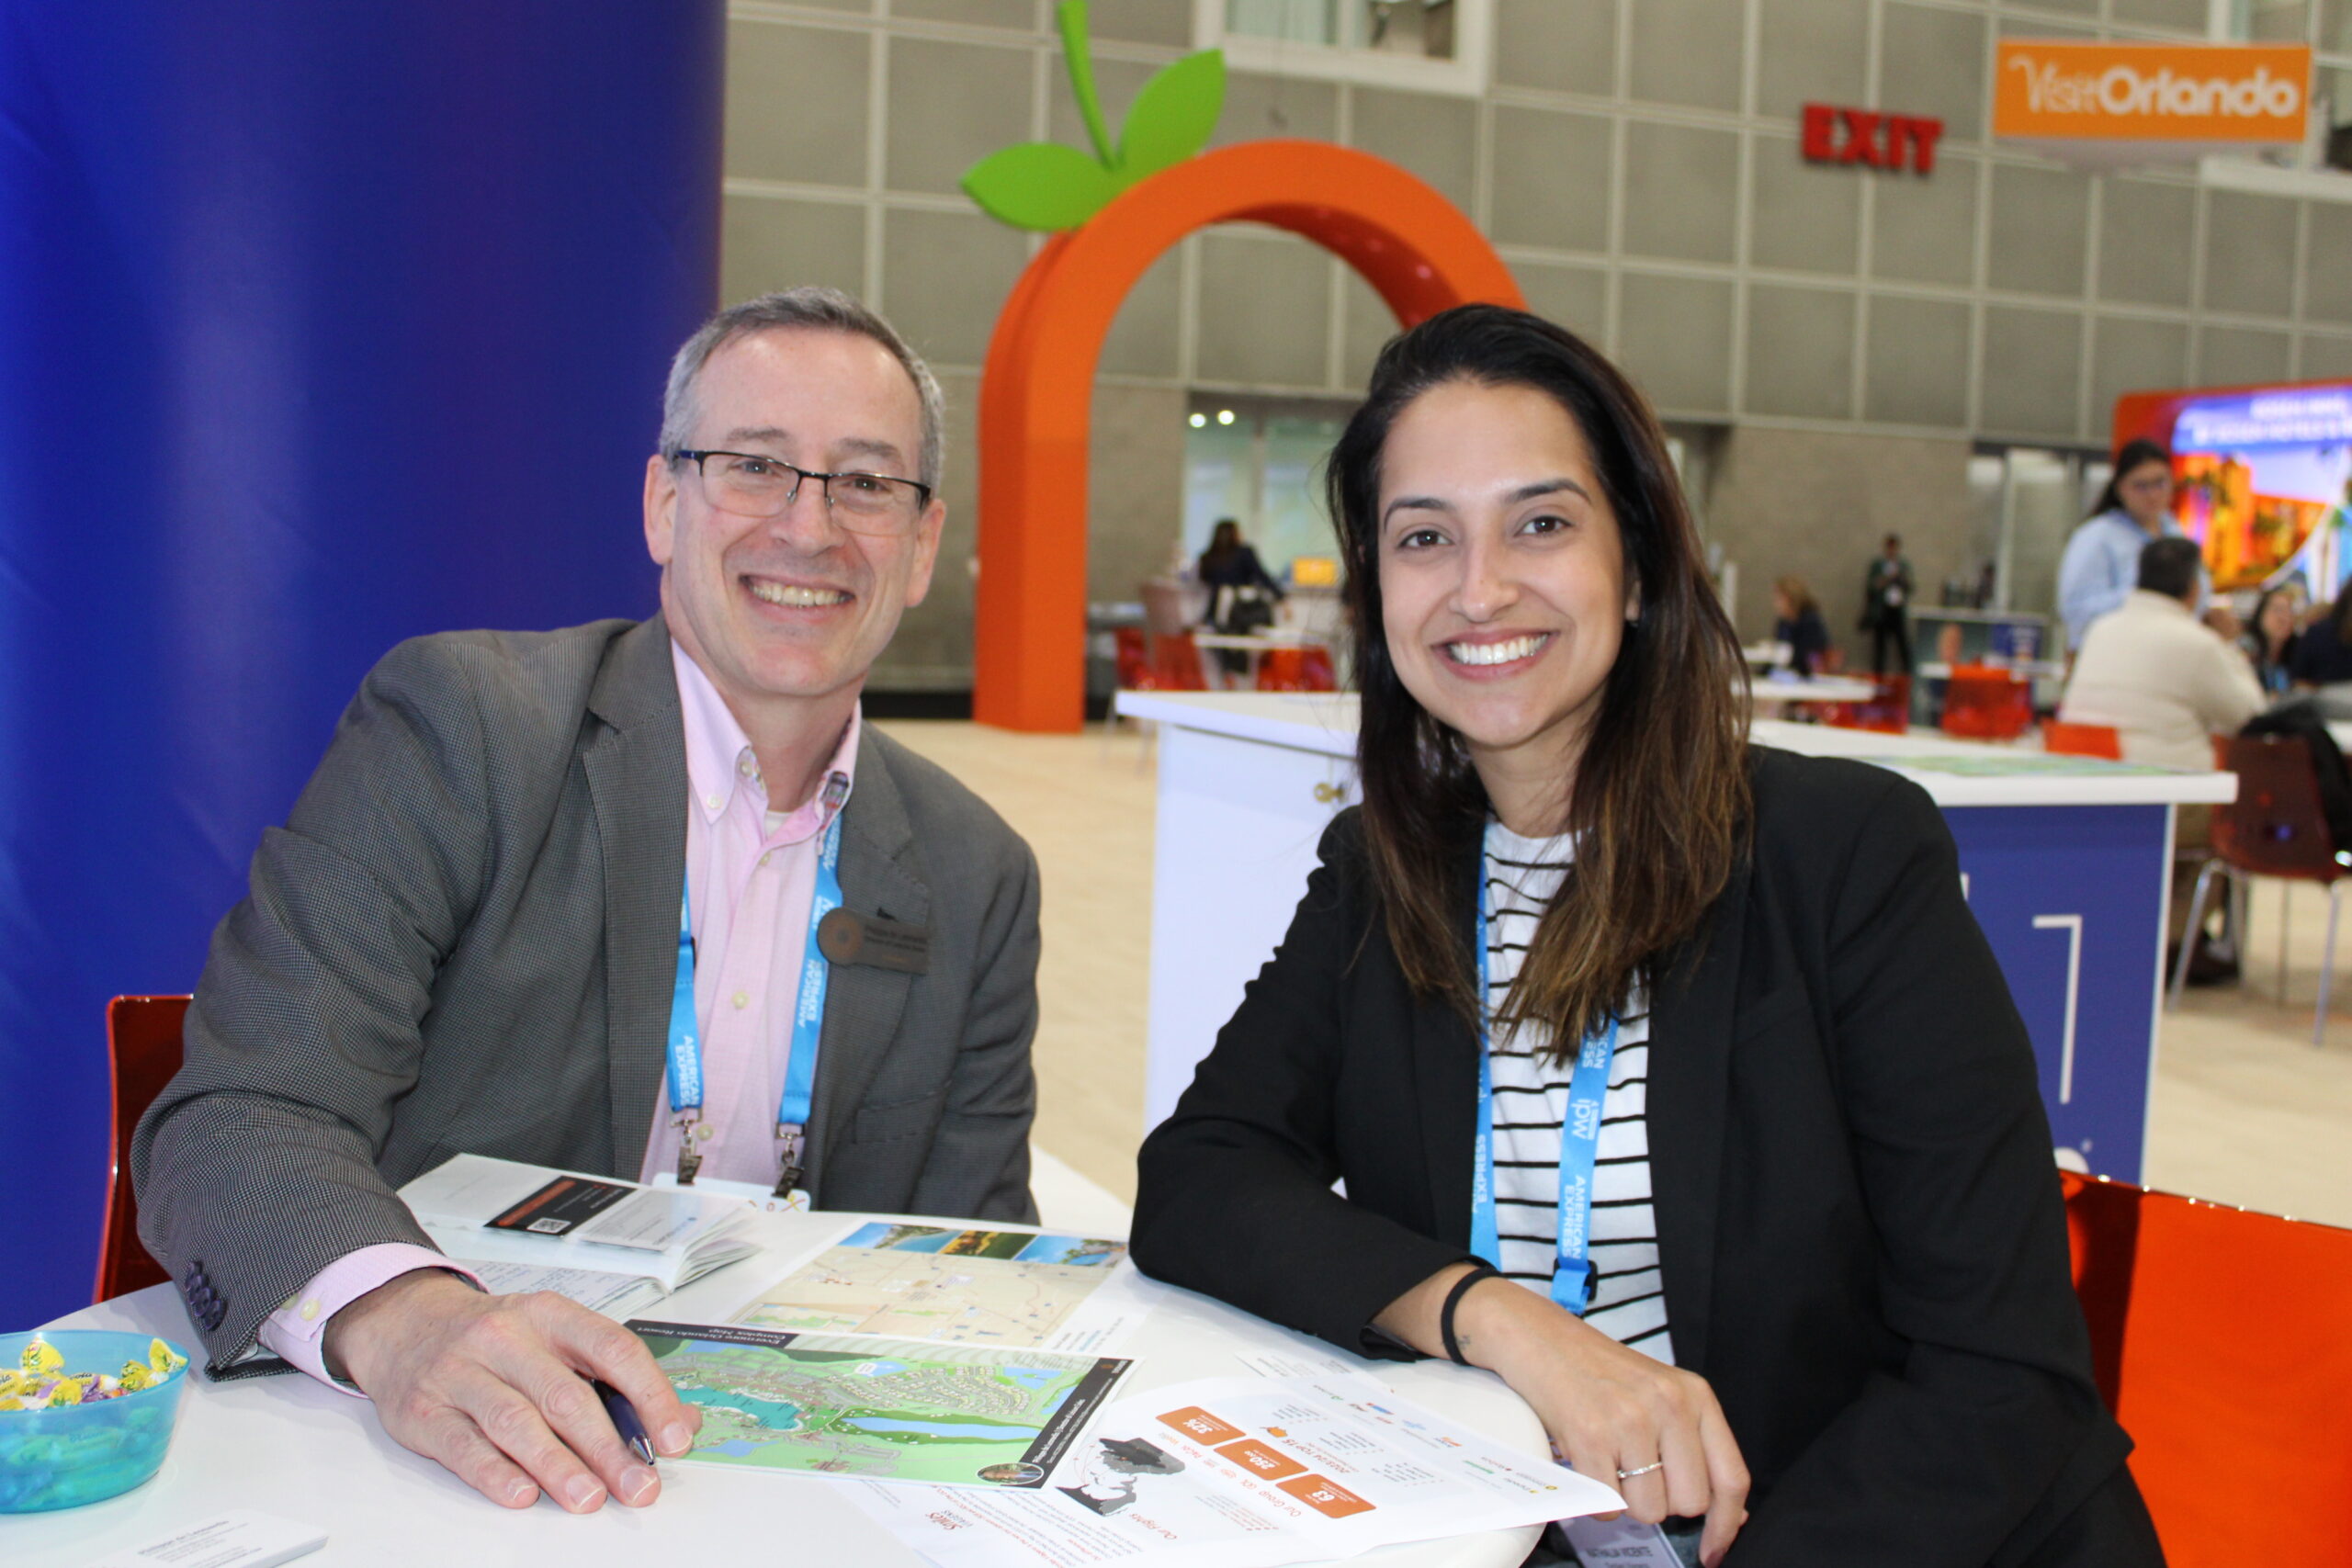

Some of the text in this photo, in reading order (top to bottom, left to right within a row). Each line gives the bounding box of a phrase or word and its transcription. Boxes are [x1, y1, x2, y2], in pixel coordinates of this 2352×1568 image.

[2098, 66, 2299, 118] Orlando
[1804, 103, 1943, 173] EXIT
[797, 959, 815, 1029] AMERICAN
[807, 960, 823, 1022] EXPRESS
[674, 1043, 689, 1108] EXPRESS
[683, 1035, 702, 1105] AMERICAN
[1475, 1134, 1487, 1204] EXPRESS
[1562, 1185, 1576, 1259] EXPRESS
[1572, 1174, 1587, 1260] AMERICAN
[1182, 1417, 1214, 1435] 32%
[1258, 1489, 1285, 1508] Group
[1311, 1489, 1336, 1503] 63
